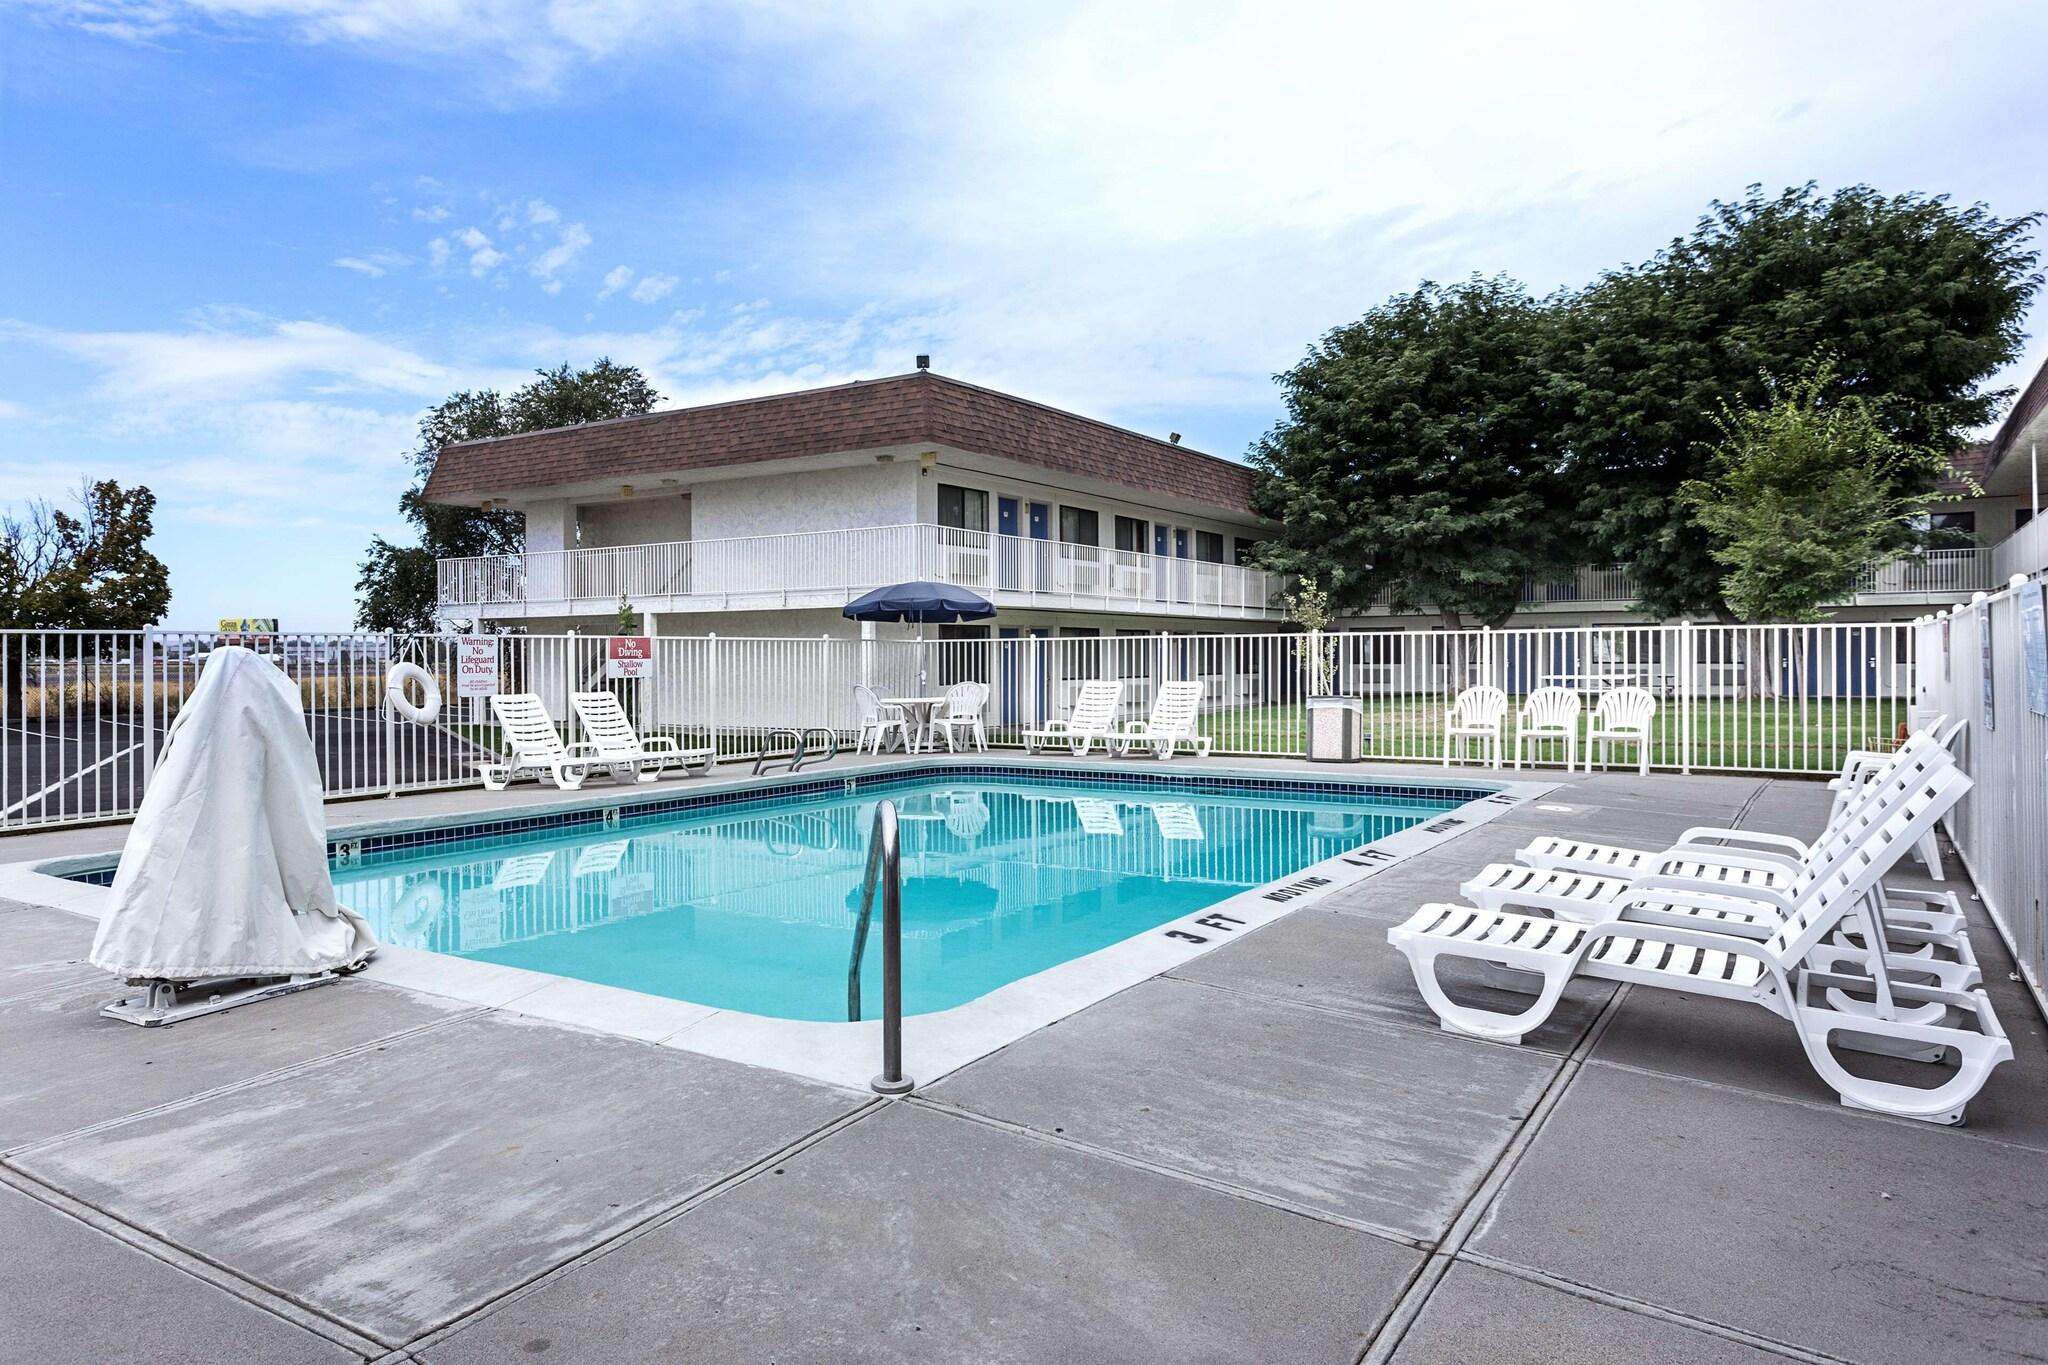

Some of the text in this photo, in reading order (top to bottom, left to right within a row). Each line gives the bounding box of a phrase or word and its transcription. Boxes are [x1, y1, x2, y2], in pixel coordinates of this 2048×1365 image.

[625, 638, 637, 648] No
[472, 646, 484, 655] No
[618, 647, 643, 658] Diving
[461, 655, 495, 665] Lifeguard
[617, 660, 644, 669] Shallow
[462, 665, 473, 674] On
[624, 668, 638, 676] Pool
[606, 809, 613, 820] 4
[340, 843, 350, 857] 3
[1342, 849, 1396, 867] 4 FT
[1165, 913, 1246, 944] 3 FT
